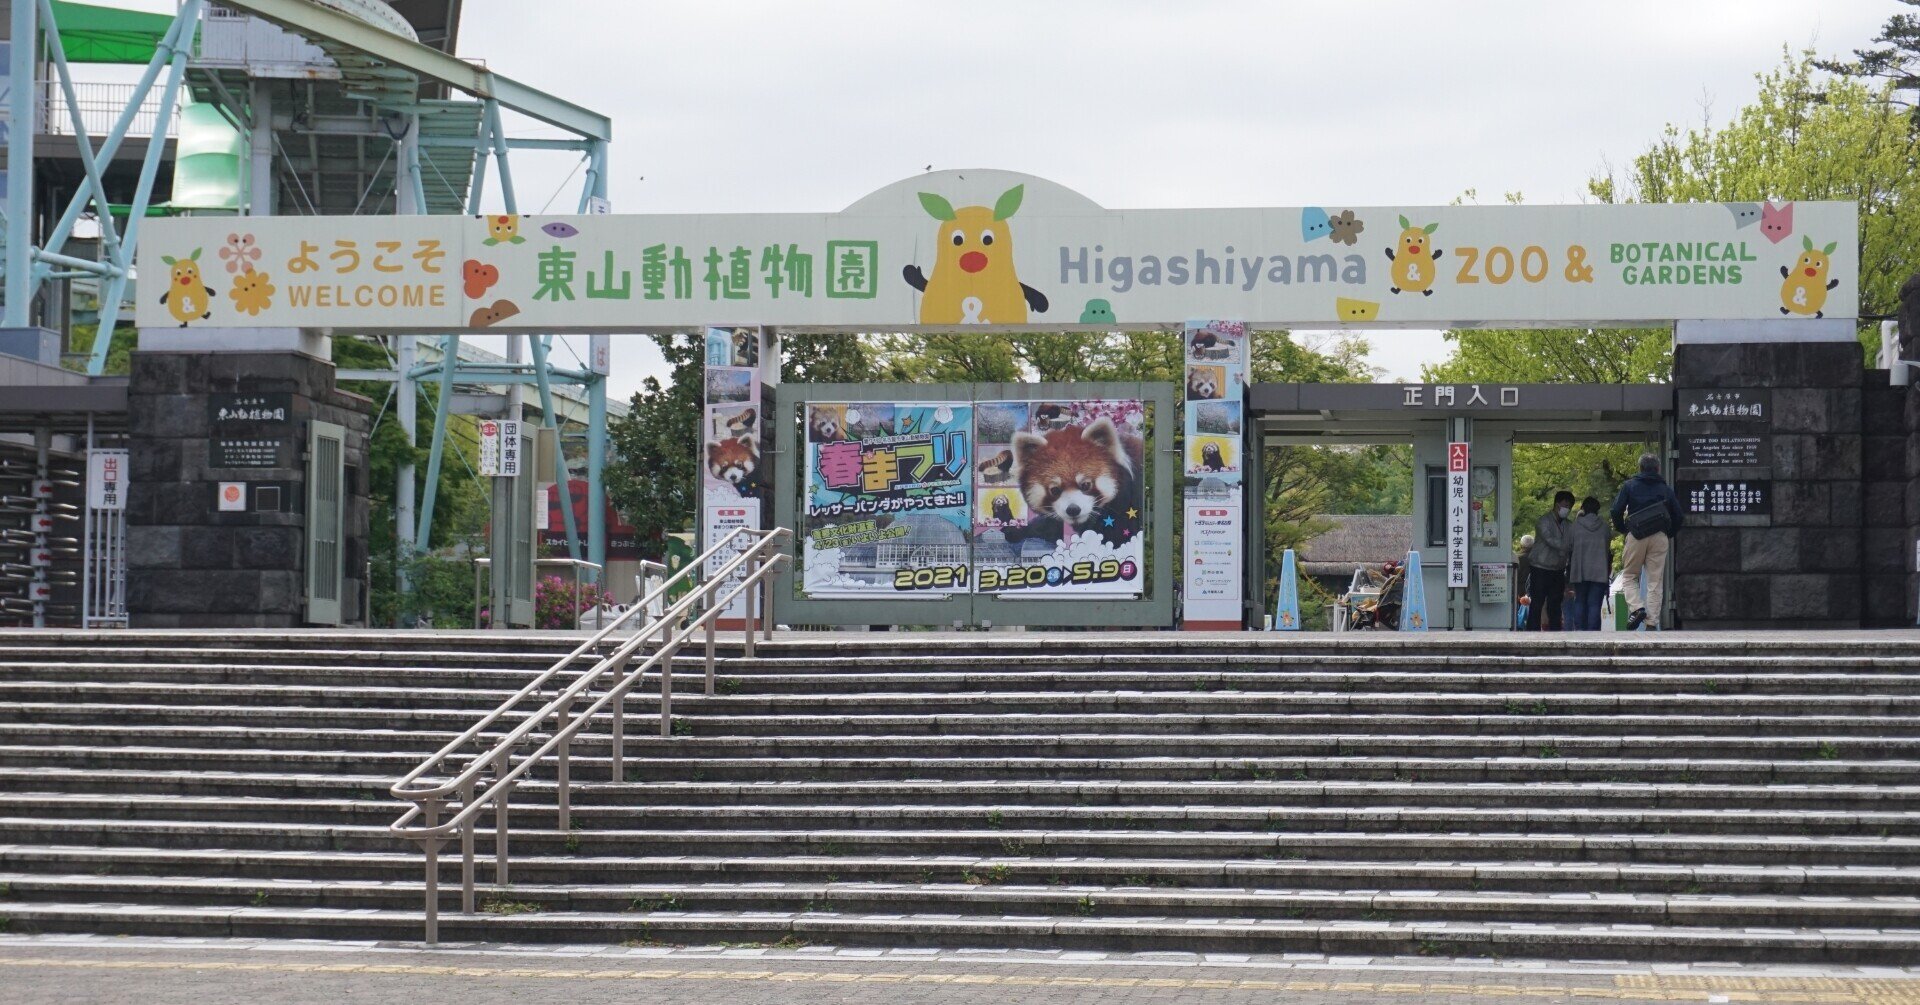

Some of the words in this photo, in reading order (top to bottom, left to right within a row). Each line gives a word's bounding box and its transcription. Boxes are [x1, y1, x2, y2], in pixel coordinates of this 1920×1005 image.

[287, 240, 446, 273] ようこそ
[1610, 241, 1757, 264] BOTANICAL
[531, 240, 879, 302] 東山動植物園
[1059, 245, 1367, 293] Higashiyama
[1454, 245, 1549, 285] ZOO
[1564, 244, 1594, 284] &
[1622, 264, 1743, 285] GARDENS
[288, 285, 446, 307] WELCOME
[1403, 385, 1519, 406] 正門入口
[1688, 403, 1762, 417] 東山動植物園
[504, 423, 517, 474] 団体専用
[1452, 446, 1464, 470] 入口
[104, 457, 117, 506] 出口専用
[894, 564, 967, 589] 2021
[980, 566, 1047, 588] 3.20
[1072, 559, 1120, 581] 5.9
